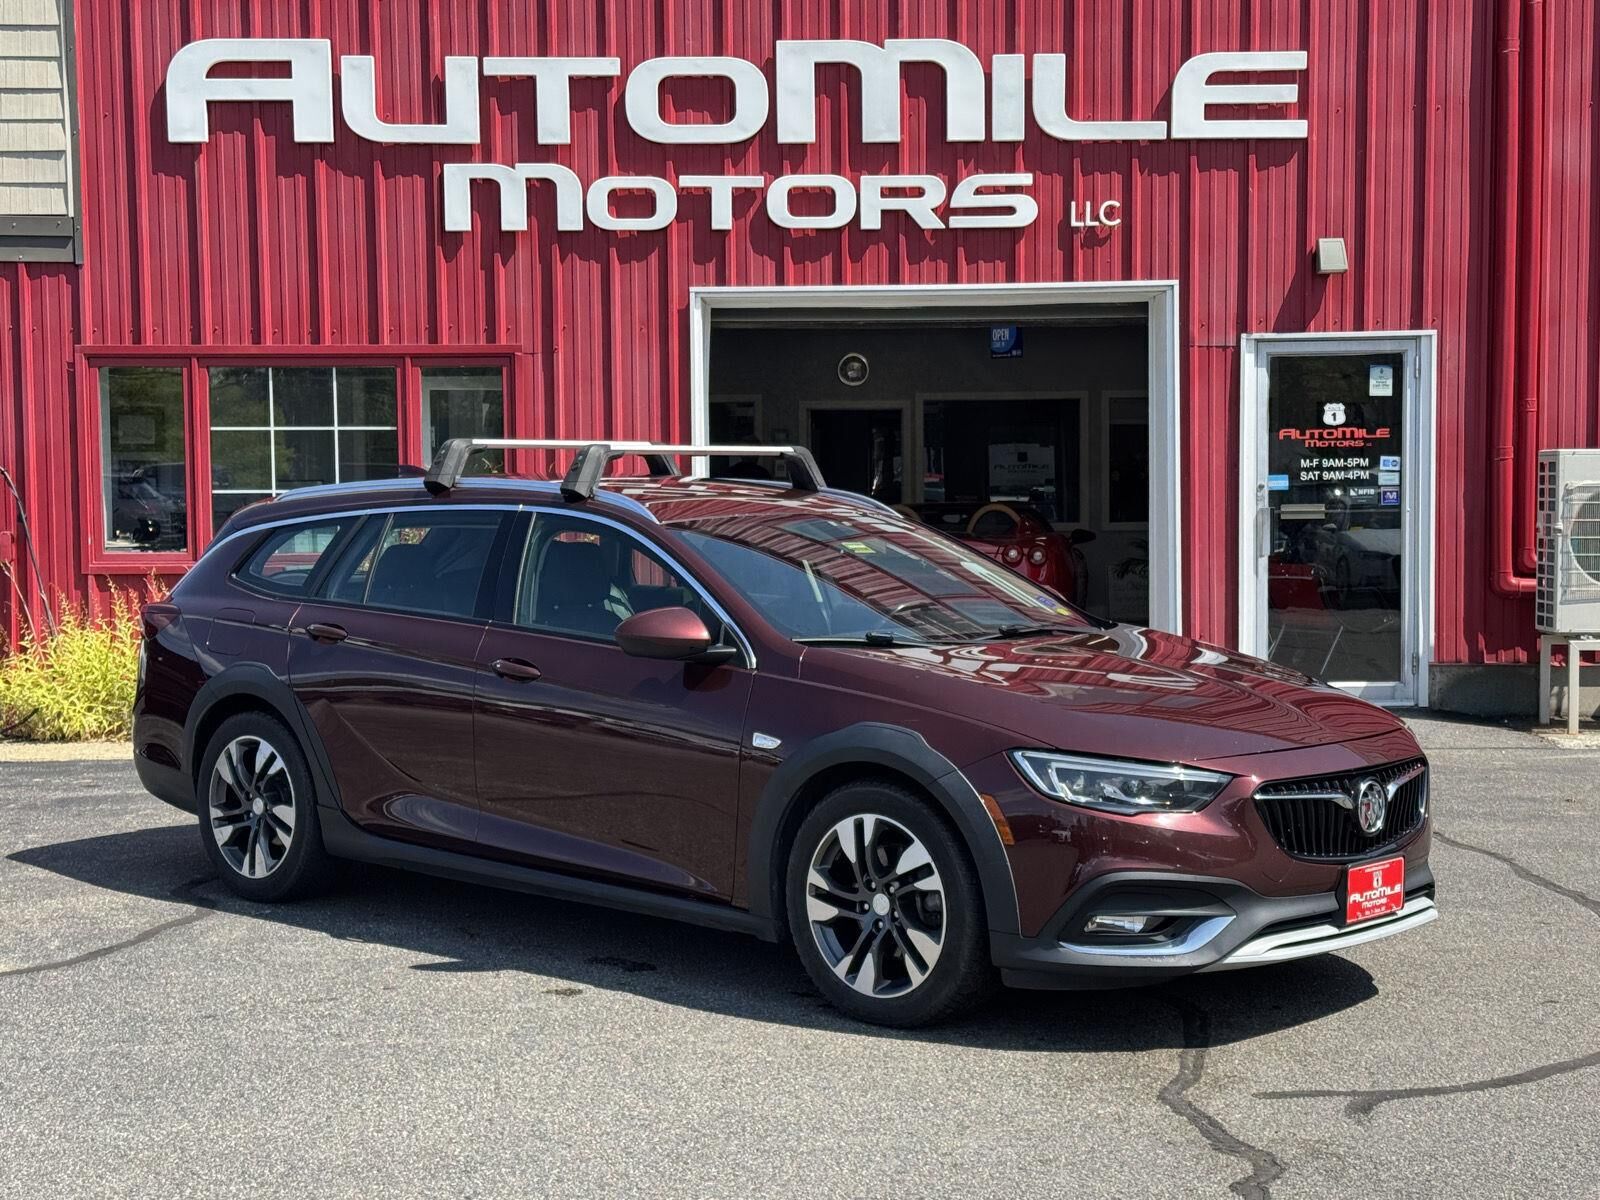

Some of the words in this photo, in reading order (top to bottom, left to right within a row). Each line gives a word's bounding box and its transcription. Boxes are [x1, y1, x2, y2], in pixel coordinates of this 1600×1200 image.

[165, 37, 1309, 145] AUTOMILE
[443, 162, 1038, 232] MOTORS
[1070, 200, 1122, 227] LLC
[992, 328, 1010, 341] OPEN
[1331, 412, 1336, 422] 1
[1279, 428, 1390, 440] AUTOMILE
[1300, 458, 1319, 468] M-F
[1322, 457, 1369, 468] 9AM-5PM
[1300, 470, 1320, 481] SAT
[1322, 470, 1370, 481] 9AM-4PM
[1350, 884, 1401, 904] AUTOMILE
